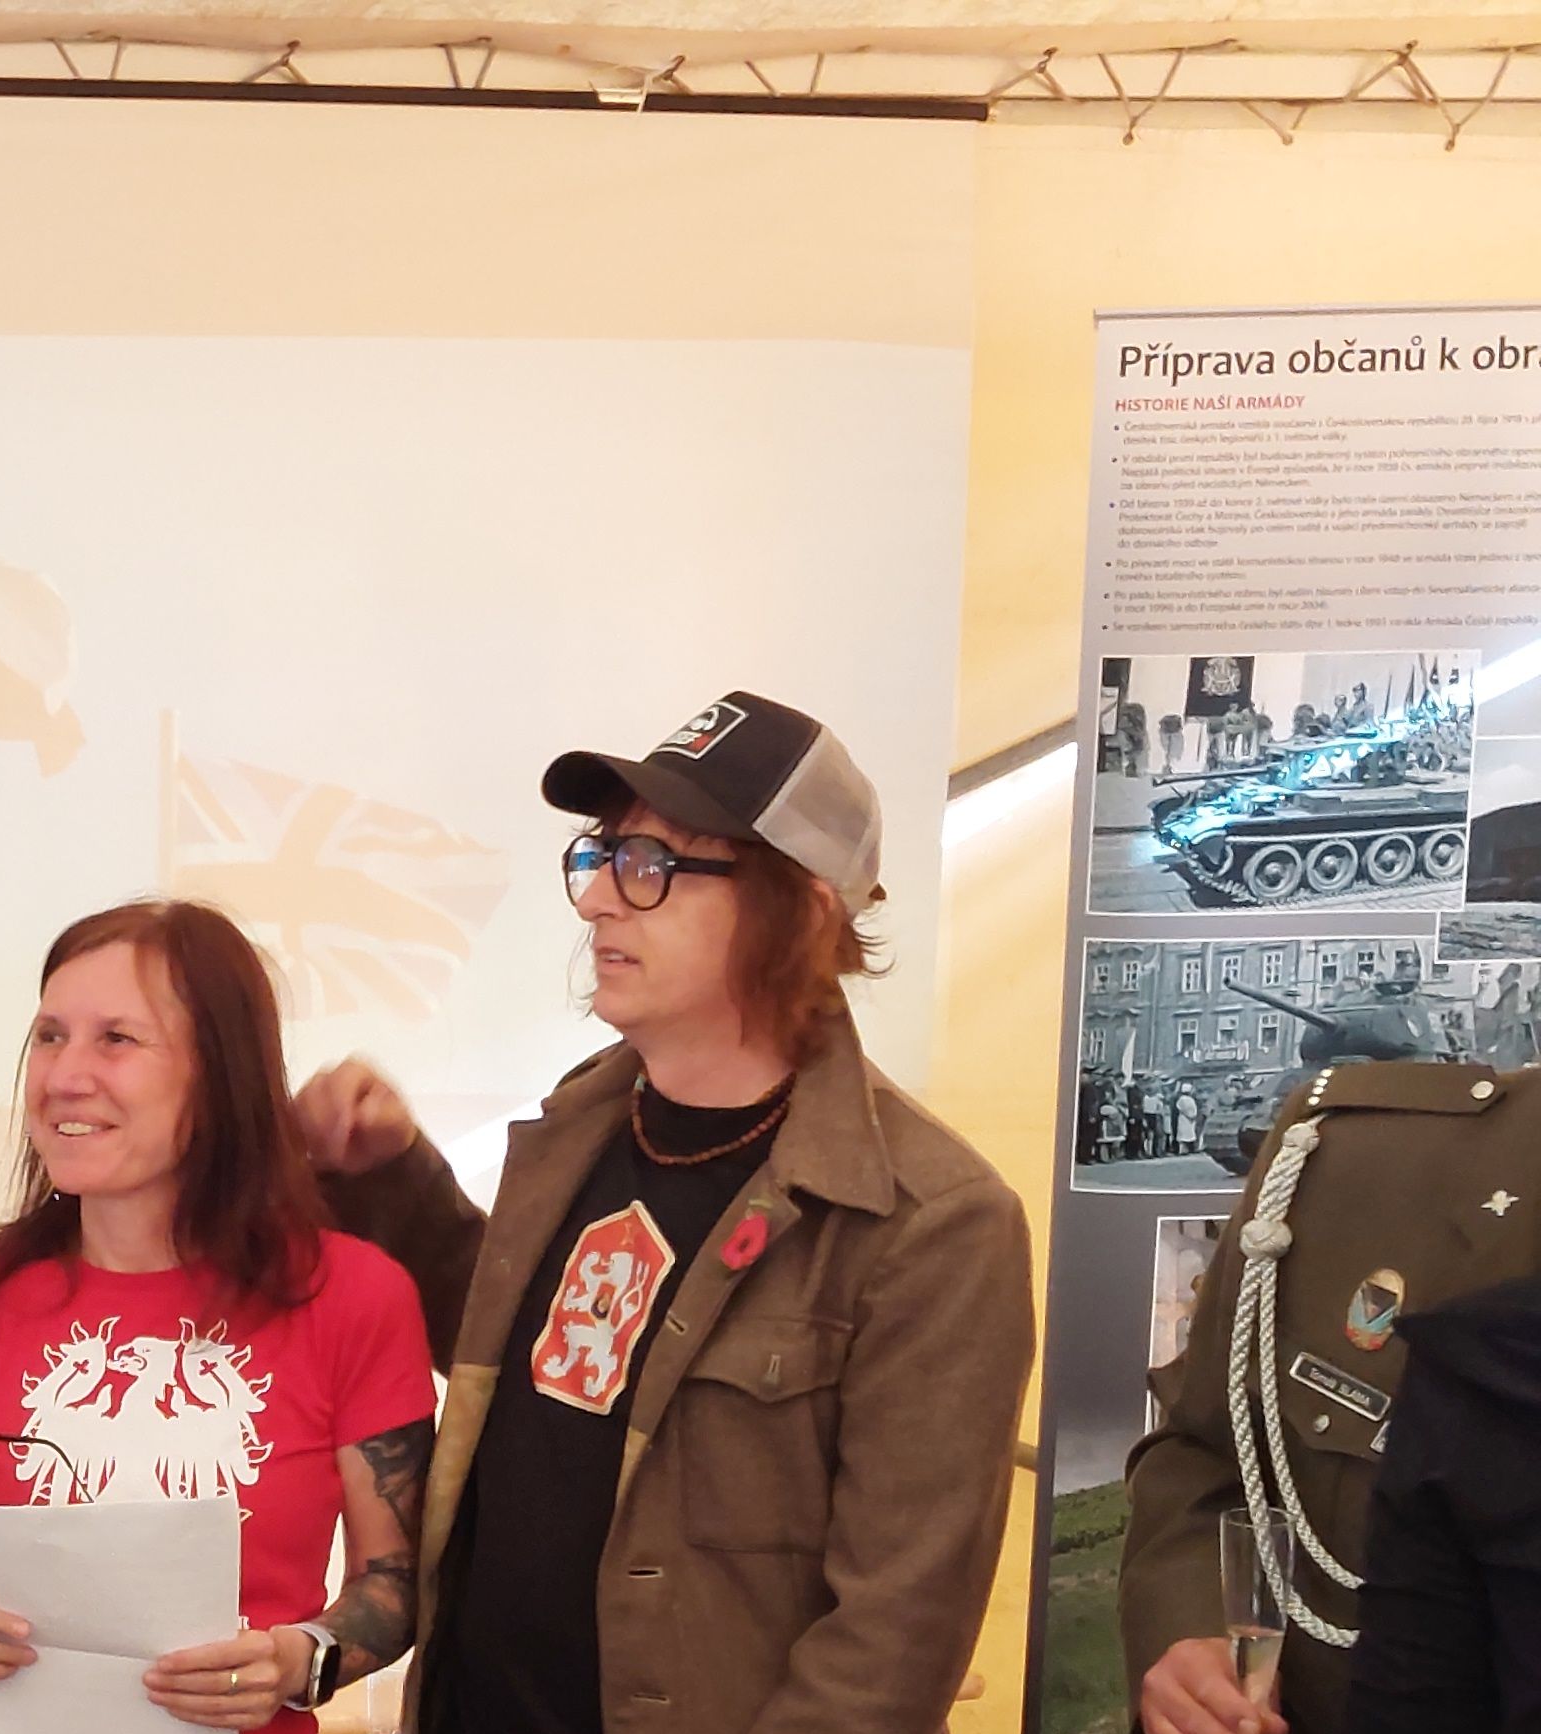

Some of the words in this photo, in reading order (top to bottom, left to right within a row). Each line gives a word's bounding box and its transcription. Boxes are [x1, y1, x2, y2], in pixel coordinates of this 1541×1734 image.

[1119, 342, 1275, 387] Příprava
[1288, 335, 1426, 375] občanů
[1440, 337, 1460, 370] k
[1472, 334, 1541, 370] obr
[1115, 396, 1189, 412] HISTORIE
[1193, 394, 1232, 411] NAŠÍ
[1235, 394, 1305, 410] ARMÁDY
